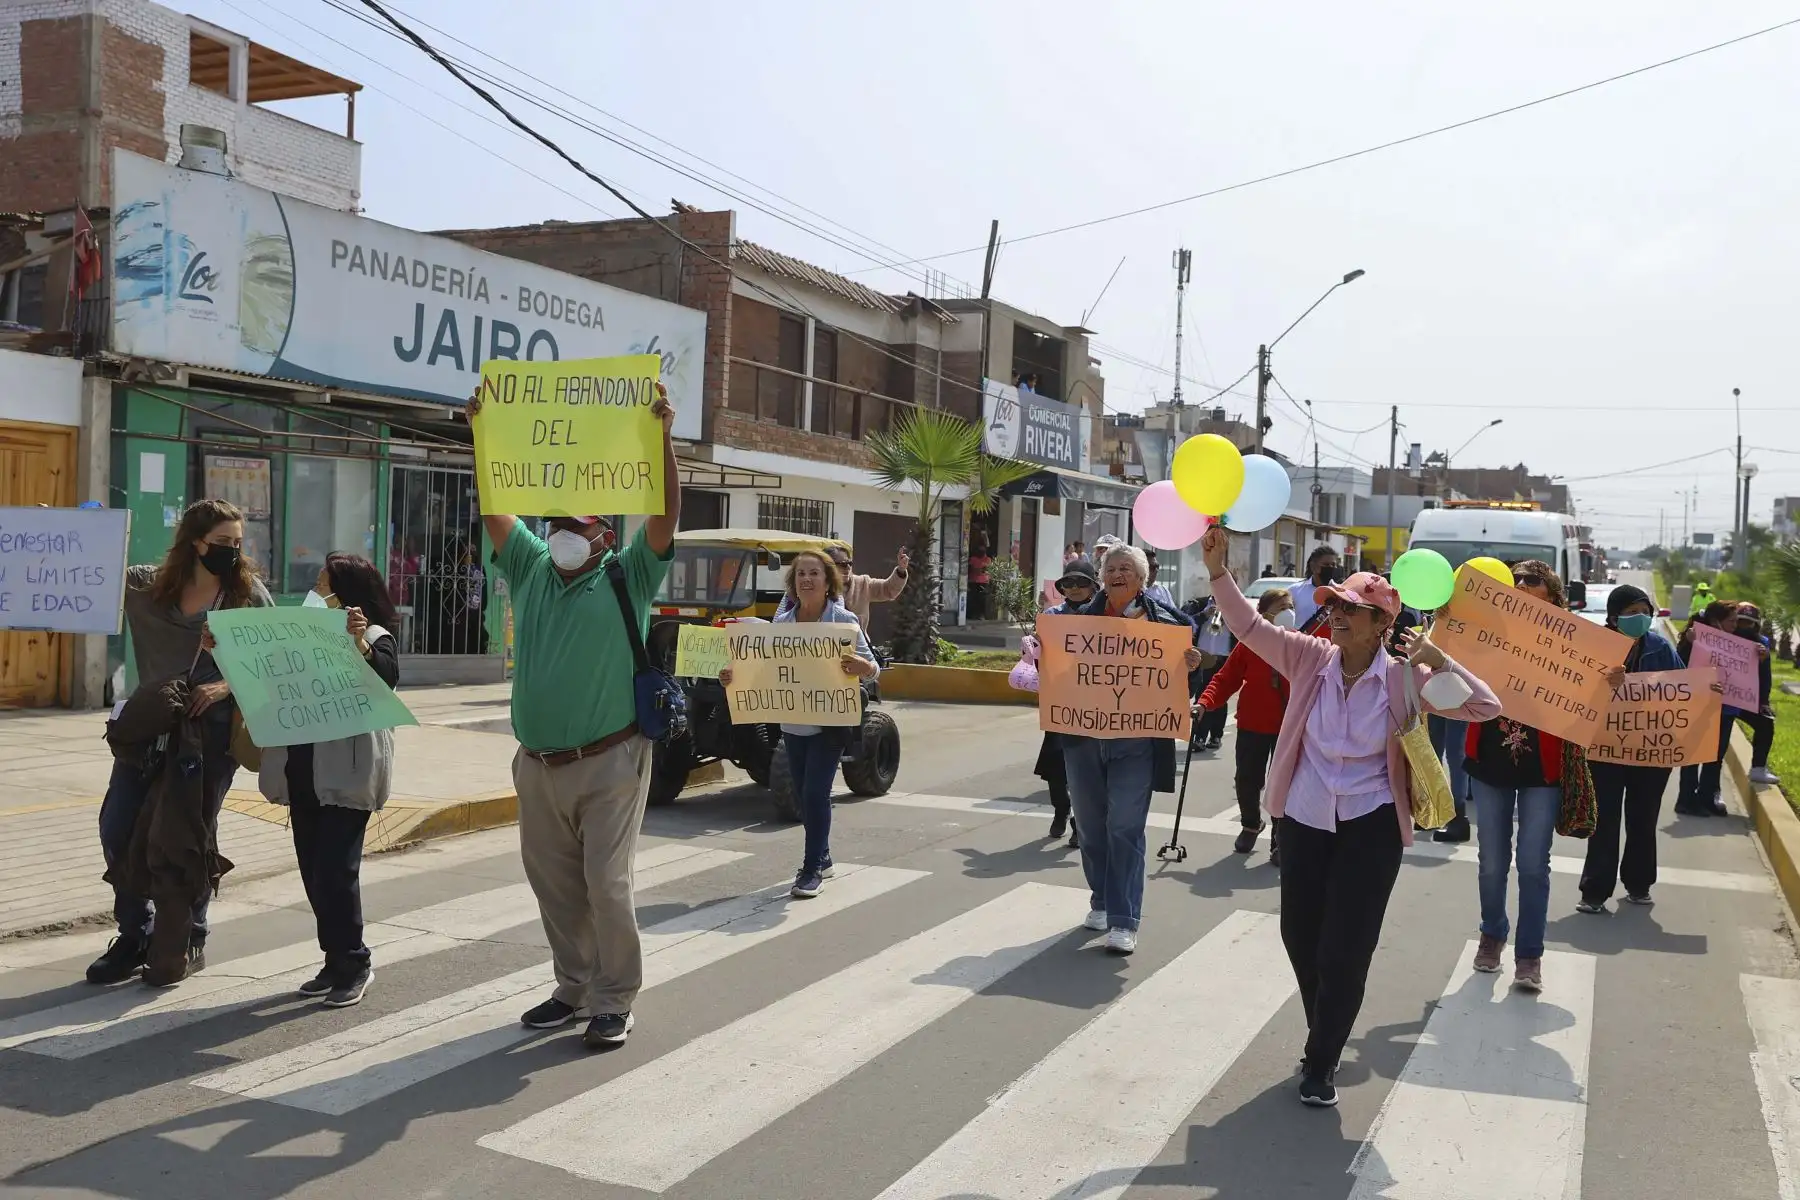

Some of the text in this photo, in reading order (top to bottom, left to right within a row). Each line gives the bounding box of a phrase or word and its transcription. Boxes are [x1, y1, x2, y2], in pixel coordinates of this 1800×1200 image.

[331, 239, 491, 304] PANADERÍA
[518, 286, 605, 331] BODEGA
[481, 374, 653, 407] NO AL ABANDONO
[1028, 404, 1071, 430] COMERCIAL
[532, 419, 578, 446] DEL
[1025, 425, 1073, 463] RIVERA
[491, 461, 654, 491] ADULTO MAYOR
[26, 557, 105, 586] LÍMITES
[0, 592, 93, 613] E EDAD
[1464, 577, 1577, 641] DISCRIMINAR
[230, 622, 306, 647] ADULTO
[1064, 633, 1164, 660] EXIGIMOS
[773, 636, 843, 661] ABANDON
[1446, 618, 1584, 687] ES DISCRIMINAR
[1536, 633, 1609, 676] LA VEJEZ
[1710, 650, 1749, 674] RESPETO
[240, 647, 306, 680] VIEJO
[778, 666, 801, 684] AL
[1077, 663, 1169, 690] RESPETO
[277, 682, 302, 701] EN
[735, 687, 857, 714] ADULTO MAYOR
[1112, 688, 1126, 710] Y
[1506, 673, 1598, 722] TU FUTURO
[1611, 680, 1691, 702] XIGIMOS
[1723, 682, 1757, 704] ERACIÓN
[277, 693, 373, 730] CONFIAR
[1051, 705, 1182, 732] CONSIDERACIÓN
[1606, 709, 1689, 732] HECHOS
[1587, 744, 1685, 764] PALABRAS
[1616, 733, 1674, 749] Y NO
